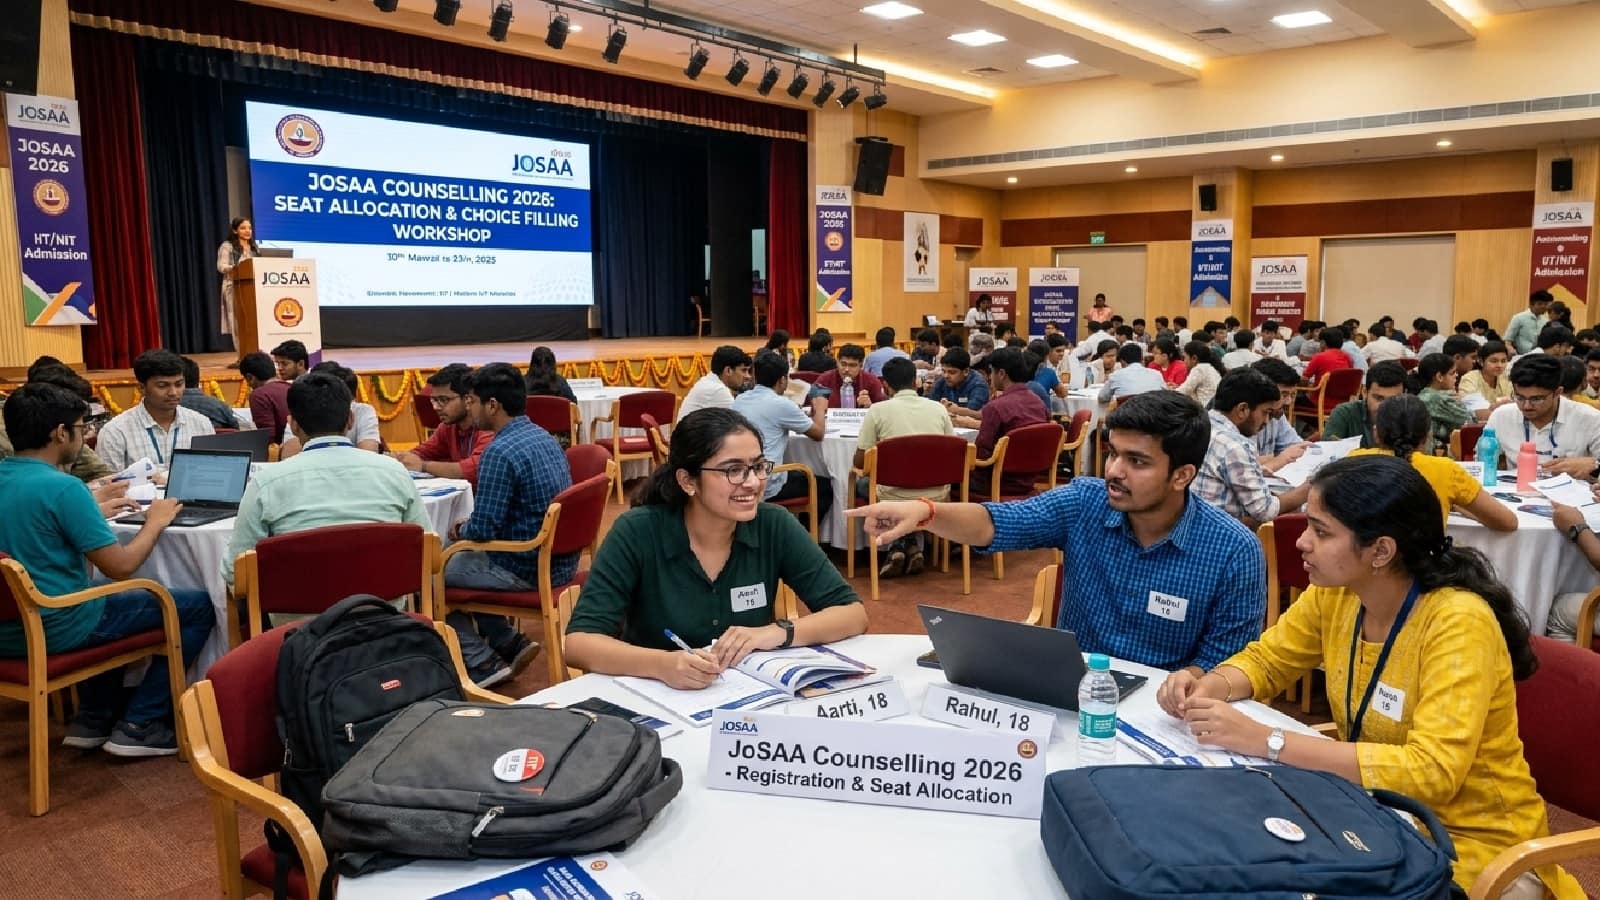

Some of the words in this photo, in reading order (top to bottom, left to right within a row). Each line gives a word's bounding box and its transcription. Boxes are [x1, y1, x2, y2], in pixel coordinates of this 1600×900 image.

[18, 104, 70, 123] JOSAA
[17, 138, 76, 157] JOSAA
[28, 157, 69, 173] 2026
[512, 153, 574, 177] JOSAA
[308, 172, 378, 195] JOSAA
[382, 178, 508, 204] COUNSELLING
[512, 189, 555, 207] 2026:
[274, 195, 323, 213] SEAT
[328, 197, 442, 220] ALLOCATION
[445, 205, 457, 221] &
[461, 207, 521, 225] CHOICE
[524, 210, 579, 228] FILLING
[1542, 211, 1583, 222] JOSAA
[392, 223, 491, 243] WORKSHOP
[24, 247, 88, 260] Admission
[261, 272, 310, 285] JOSAA
[1260, 264, 1297, 274] JOSAA
[867, 692, 889, 711] 18
[945, 696, 1001, 729] Rahul,
[1008, 711, 1030, 732] 18
[719, 721, 758, 733] JOSAA
[728, 740, 806, 764] JoSAA
[813, 745, 955, 781] Counselling
[964, 757, 1022, 782] 2026
[736, 765, 845, 791] Registration
[851, 776, 865, 792] &
[870, 777, 912, 796] Seat
[916, 781, 1013, 806] Allocation
